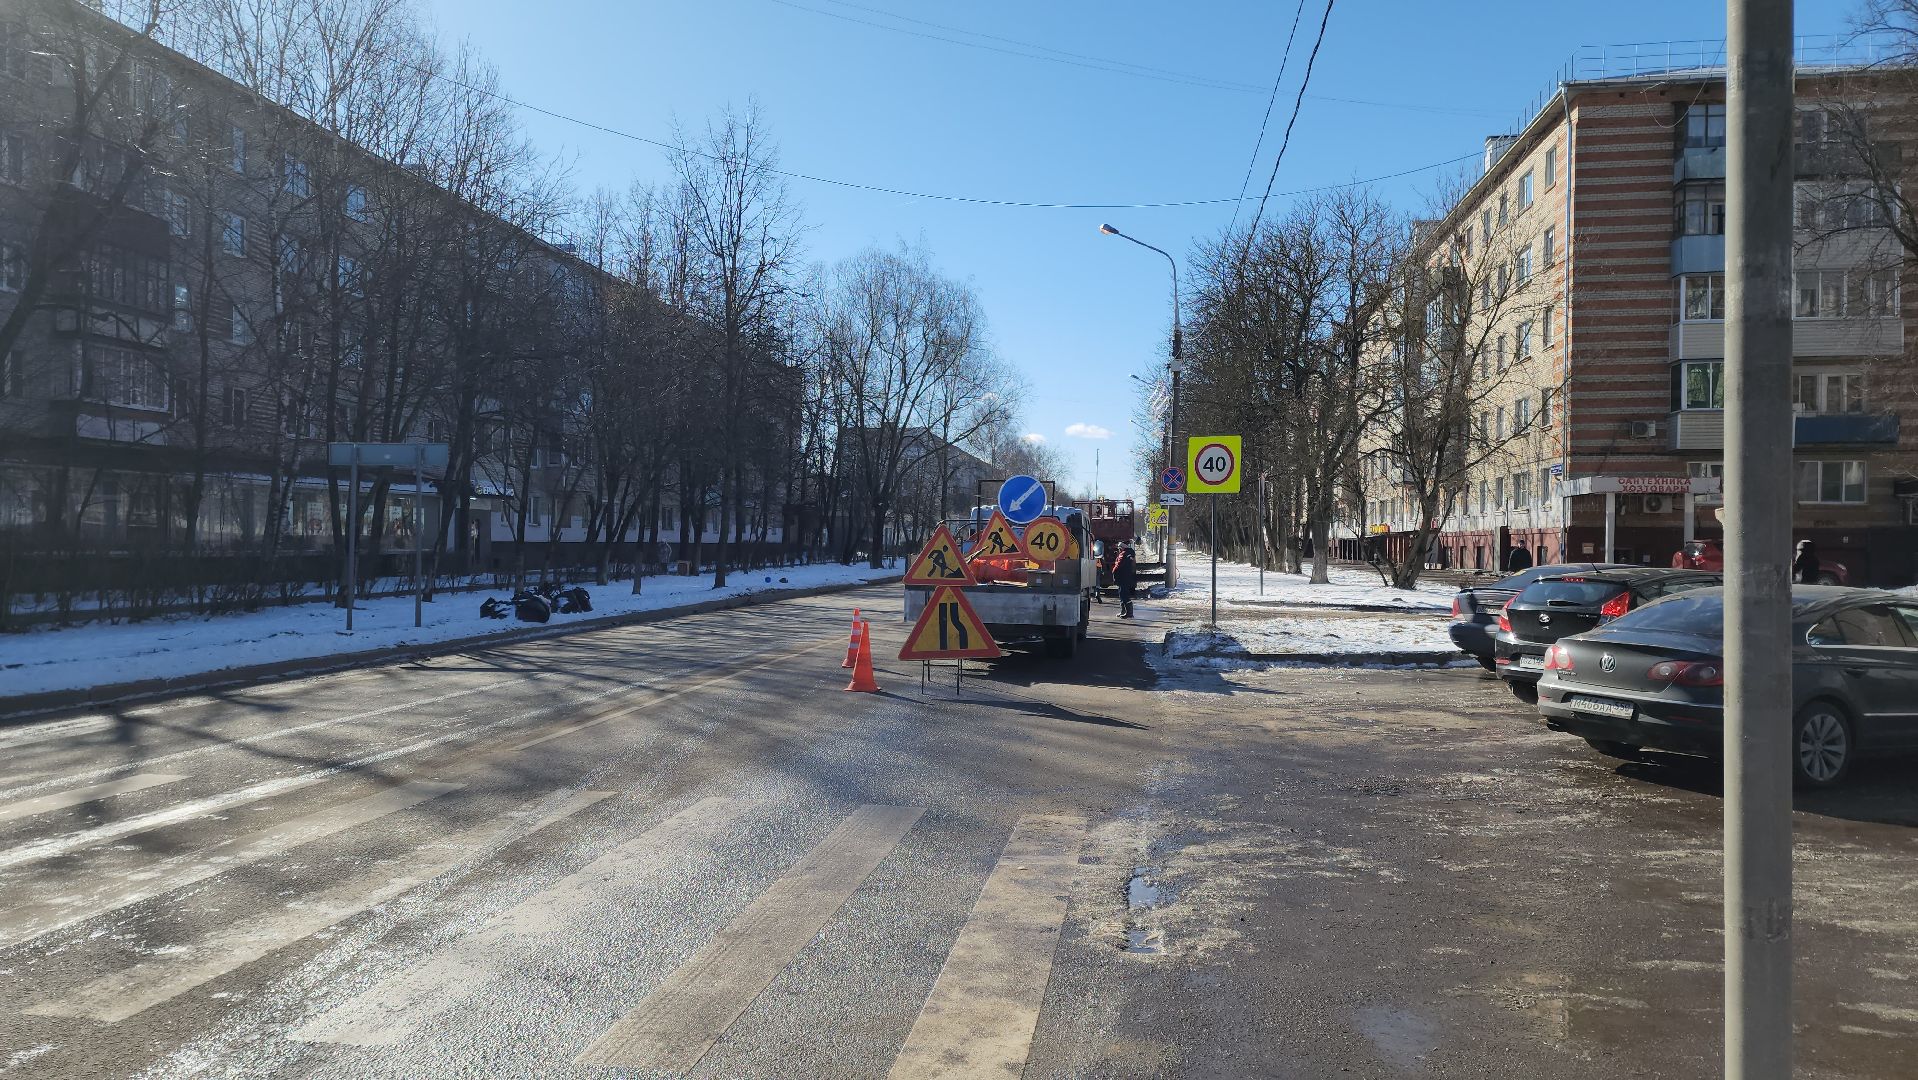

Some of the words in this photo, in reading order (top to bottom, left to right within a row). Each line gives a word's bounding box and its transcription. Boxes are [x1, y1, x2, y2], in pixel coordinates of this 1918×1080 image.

[1203, 456, 1227, 473] 40
[1618, 477, 1691, 485] САНТЕХНИКА
[1622, 485, 1690, 493] ХОЗТОВАРЫ
[1031, 531, 1059, 551] 40
